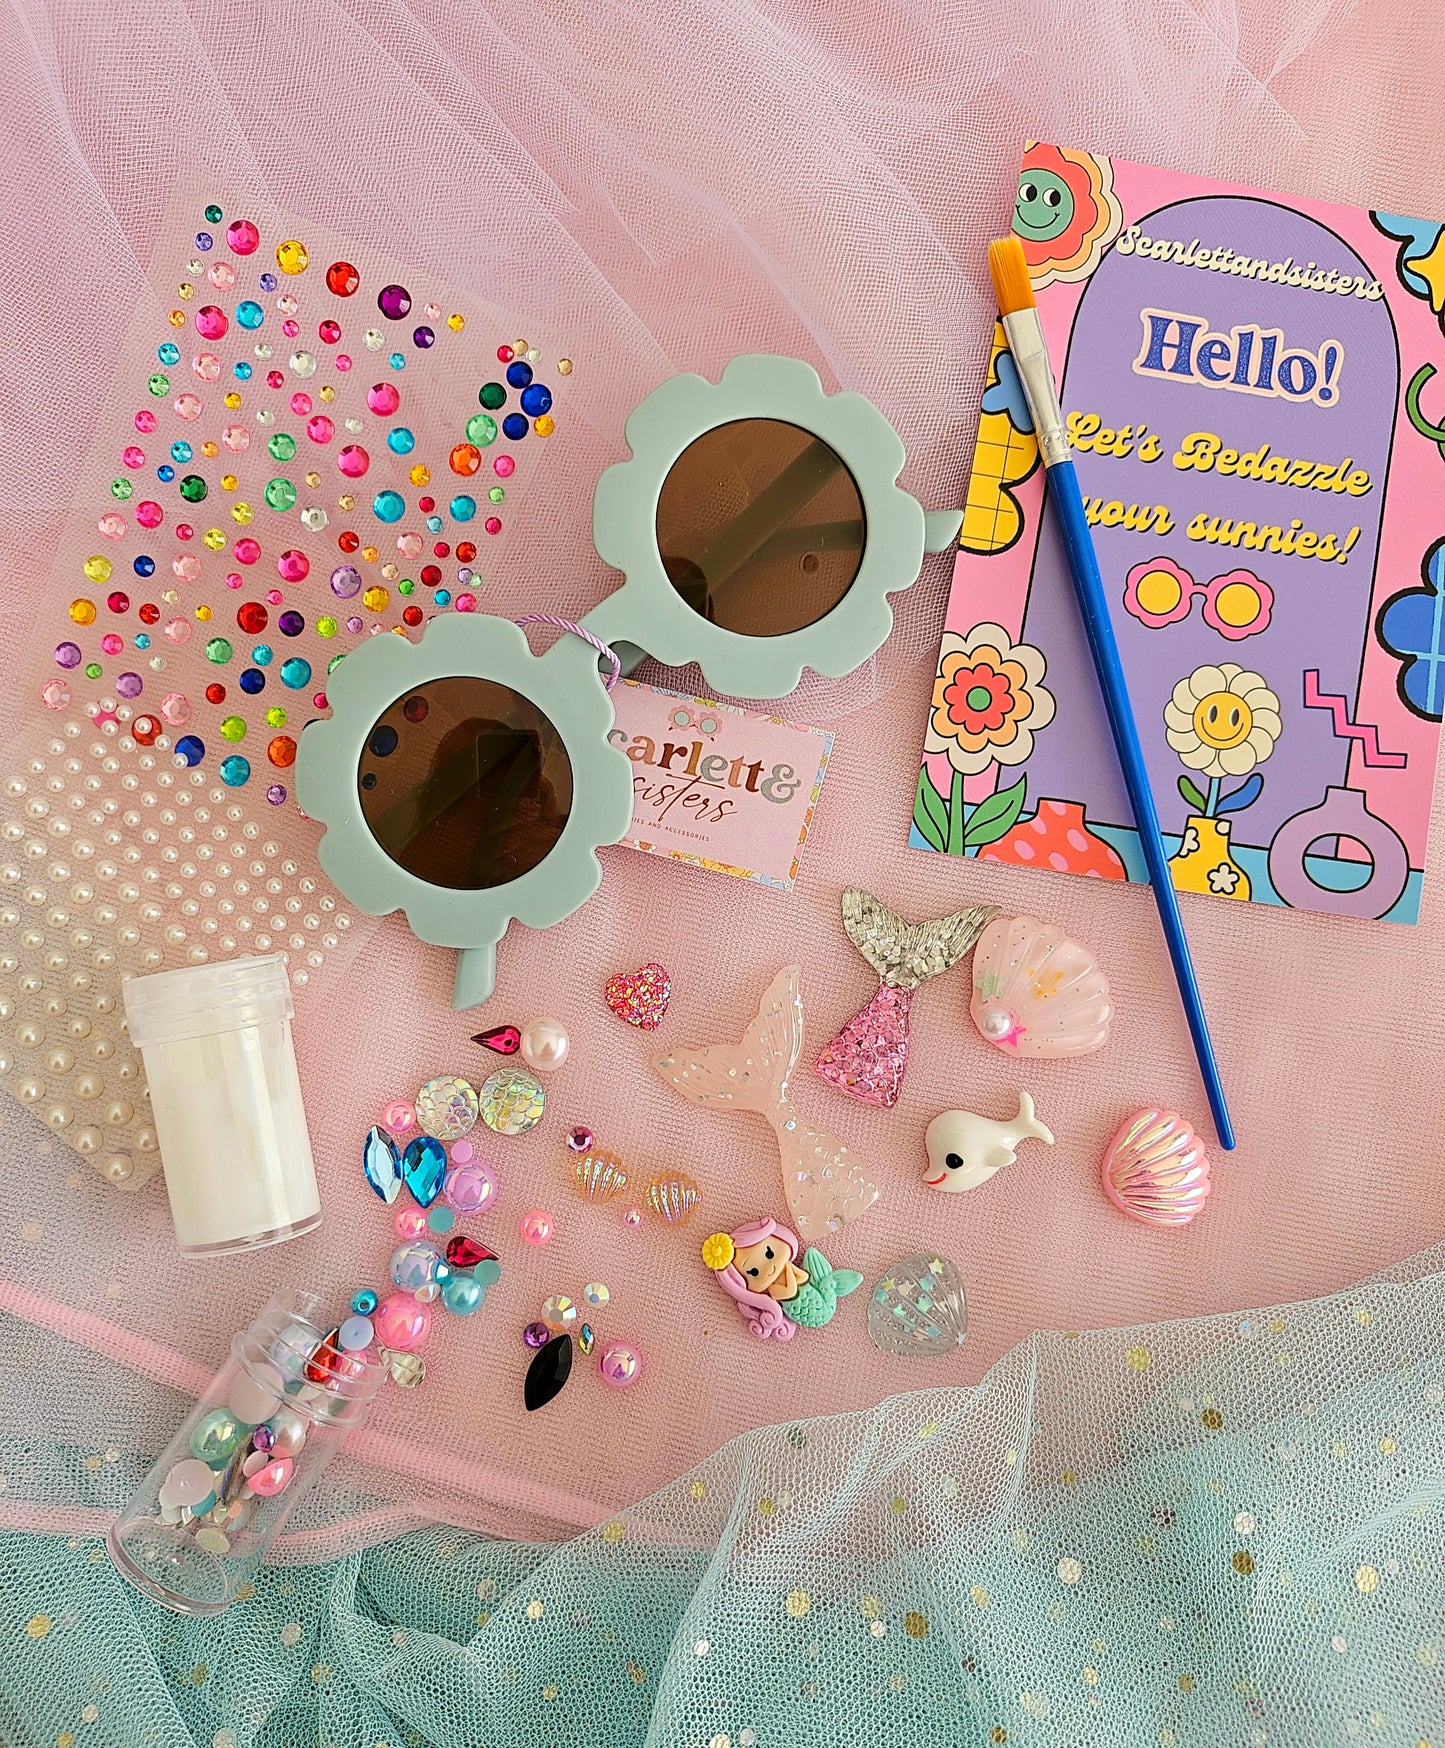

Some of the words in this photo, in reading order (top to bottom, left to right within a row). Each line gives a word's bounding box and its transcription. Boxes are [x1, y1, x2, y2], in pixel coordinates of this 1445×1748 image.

[1115, 225, 1385, 301] Scarlettandsisters
[1138, 313, 1340, 402] Hello!
[1066, 411, 1164, 464] Let's
[1172, 431, 1374, 497] Bedazzle
[1186, 511, 1362, 565] sunnies!
[631, 817, 645, 825] IES
[648, 821, 662, 829] AND
[665, 826, 710, 842] ACCESSORIES
